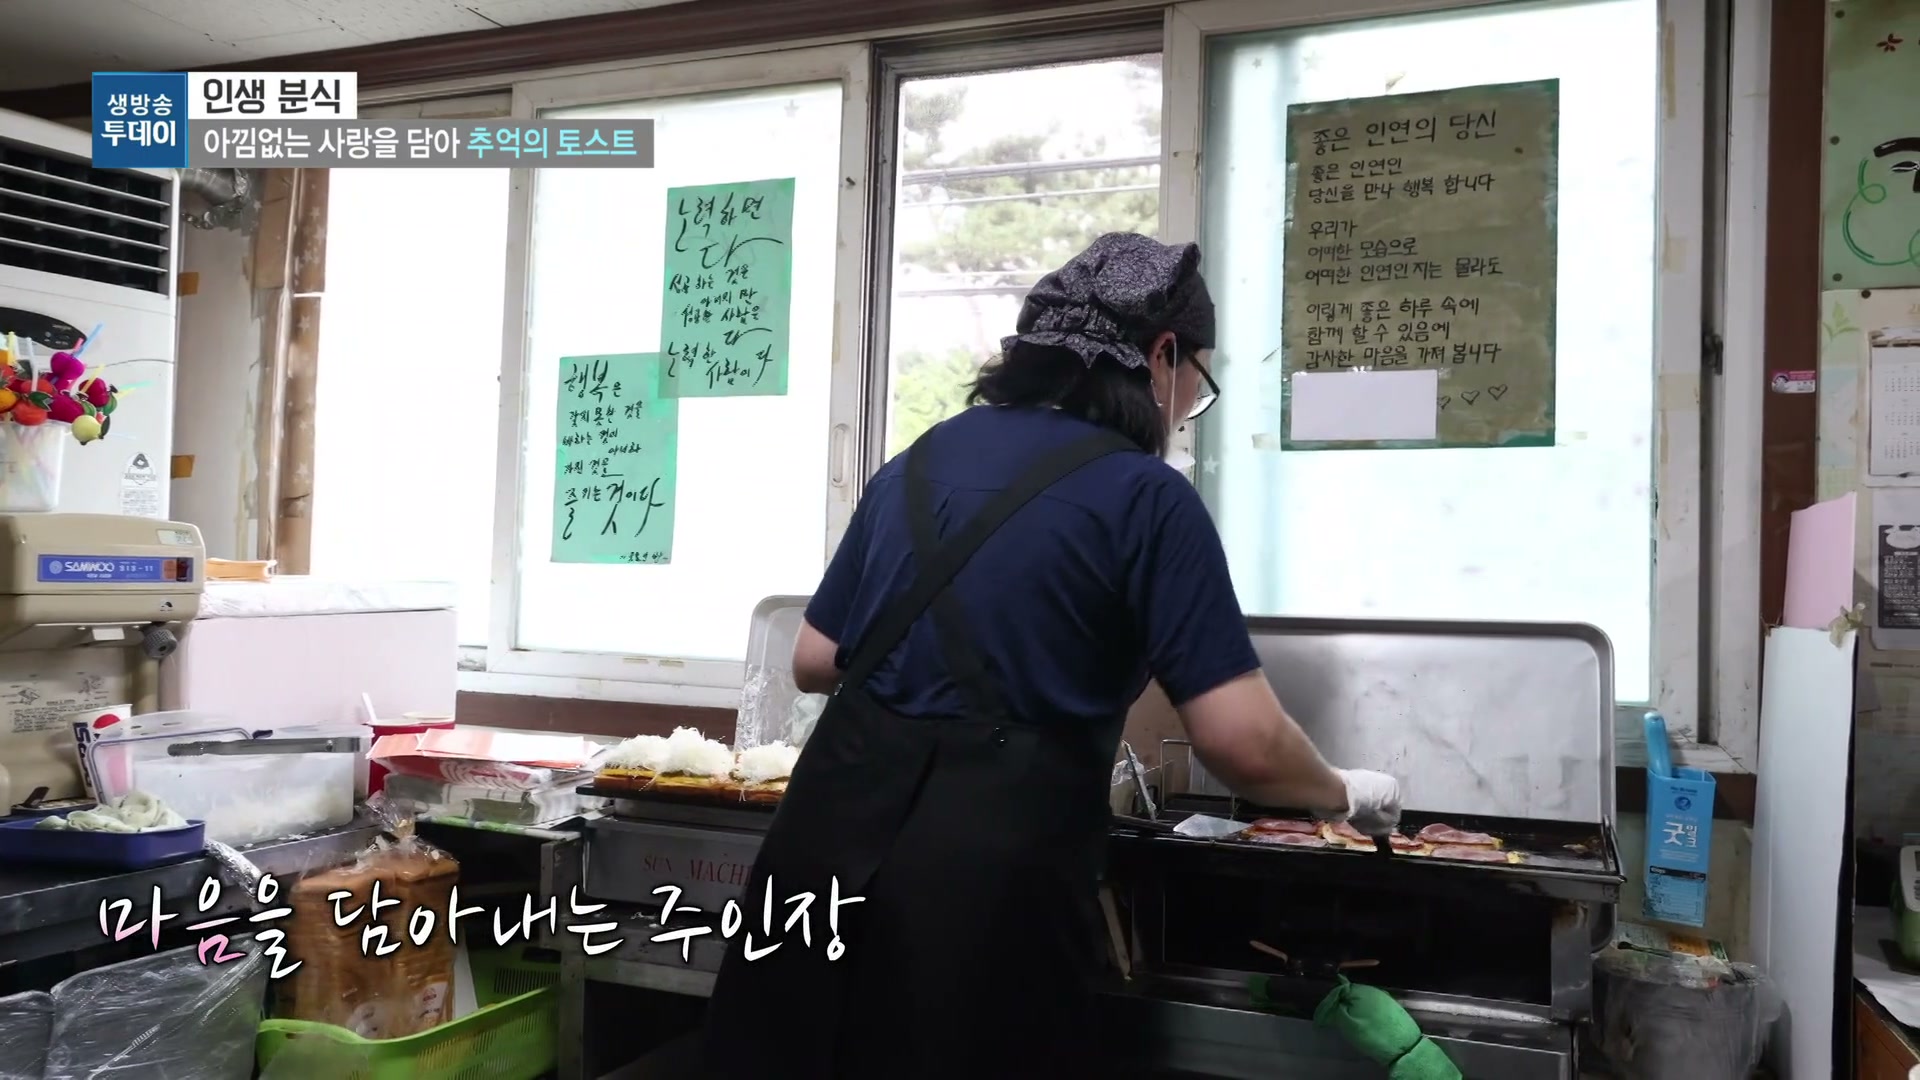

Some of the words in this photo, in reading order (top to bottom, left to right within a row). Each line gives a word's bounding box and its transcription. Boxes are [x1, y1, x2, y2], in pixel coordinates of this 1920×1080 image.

[1313, 127, 1351, 155] 좋은
[1366, 116, 1436, 147] 인연의
[1450, 110, 1496, 140] 당신
[1311, 164, 1340, 183] 좋은
[1350, 158, 1402, 178] 인연인
[1309, 184, 1354, 204] 당신을
[1364, 183, 1395, 201] 만나
[1403, 177, 1433, 198] 행복
[1444, 174, 1495, 195] 합니다
[1309, 220, 1358, 239] 우리가
[1360, 237, 1418, 259] 모습으로
[1455, 257, 1503, 277] 몰라도
[1307, 303, 1352, 322] 이렇게
[1361, 300, 1391, 323] 좋은
[1400, 298, 1432, 318] 하루
[1441, 296, 1479, 315] 속에
[1308, 326, 1343, 346] 함께
[1352, 324, 1368, 344] 할
[1373, 324, 1388, 343] 수
[1398, 321, 1449, 342] 있음에
[1306, 349, 1354, 370] 감사한
[1363, 345, 1408, 367] 마음을
[1453, 343, 1501, 364] 봅니다
[65, 562, 114, 572] SAMWOO
